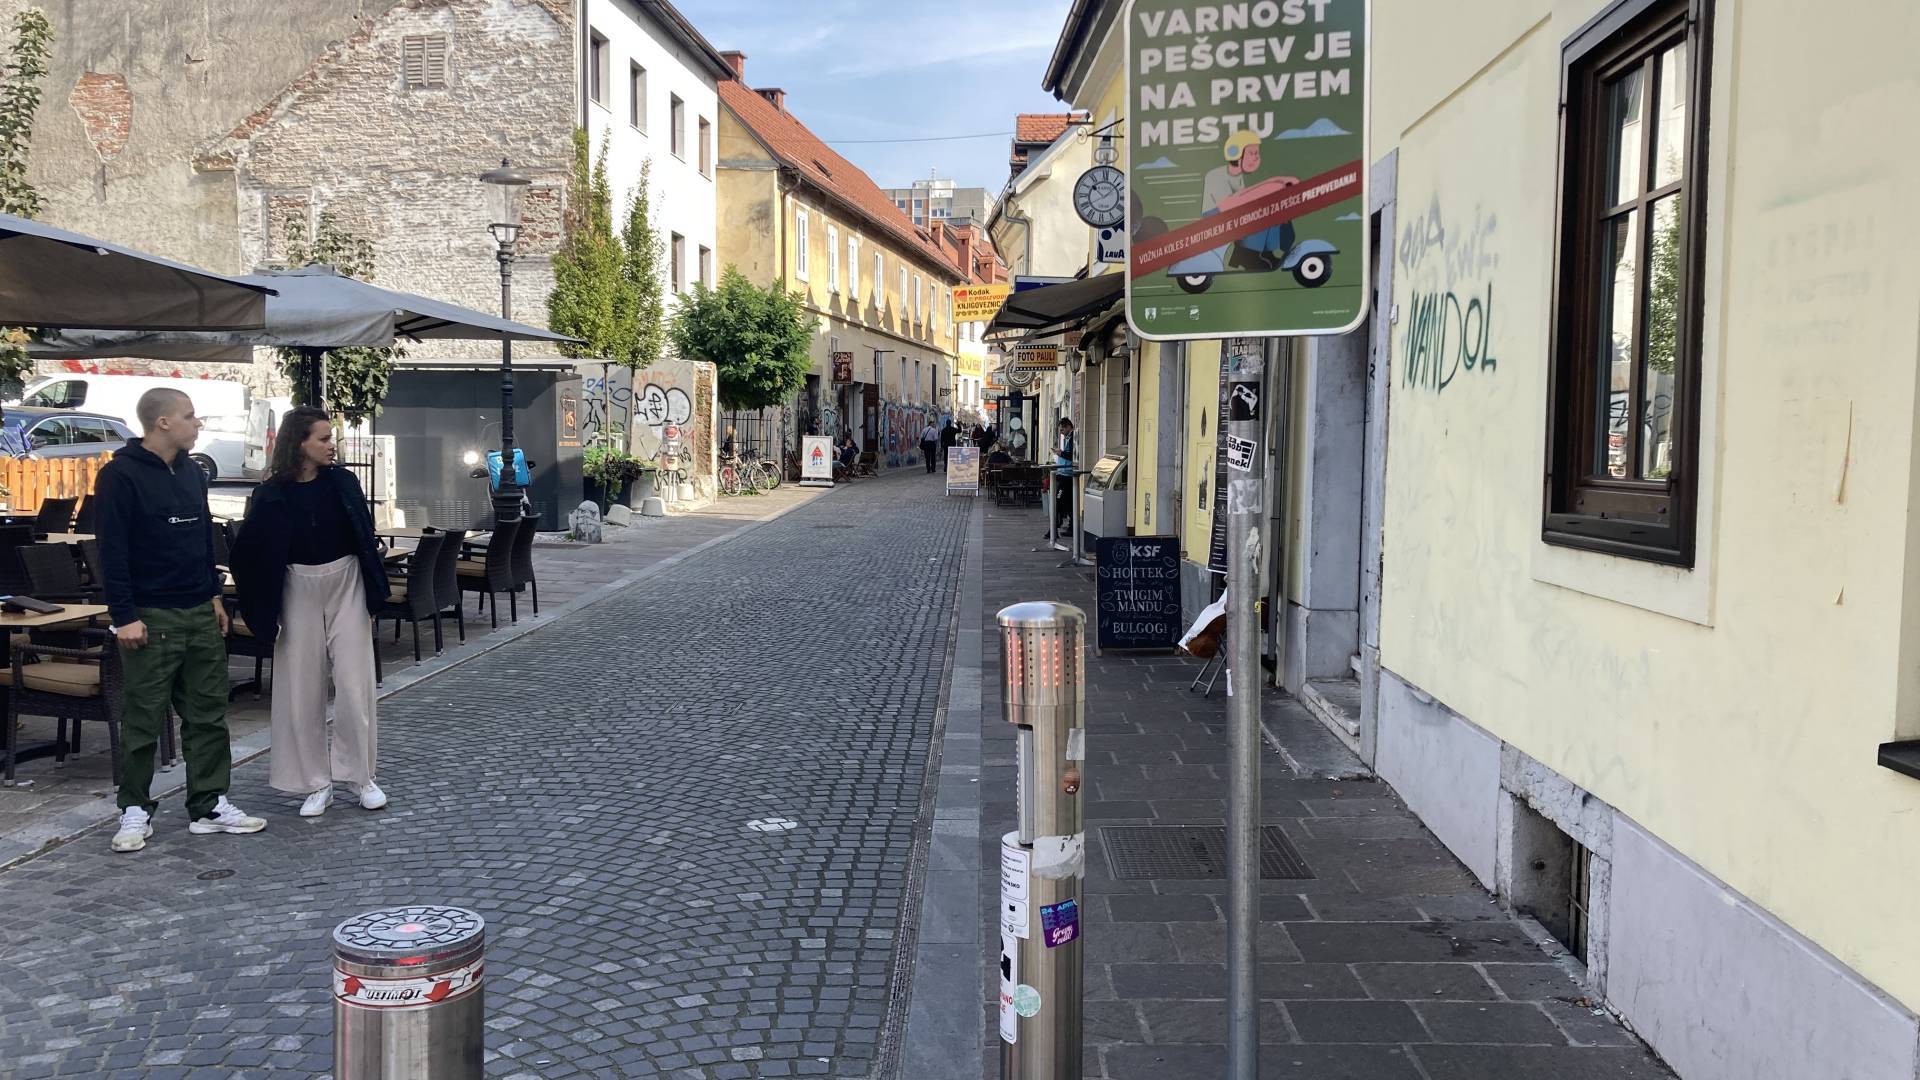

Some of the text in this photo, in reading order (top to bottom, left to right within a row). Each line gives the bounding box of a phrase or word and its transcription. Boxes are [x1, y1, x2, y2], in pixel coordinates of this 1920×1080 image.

[1139, 0, 1331, 38] VARNOST
[1140, 31, 1351, 75] PEŠCEV JE
[1140, 68, 1350, 111] NA PRVEM
[1140, 112, 1275, 148] MESTU
[1139, 247, 1163, 264] VOŽNJA
[1164, 240, 1184, 255] KOLES
[1185, 237, 1190, 247] Z
[1190, 224, 1225, 244] MOTORJEM
[1225, 221, 1233, 231] JE
[1233, 218, 1239, 228] V
[1270, 203, 1280, 215] ZA
[1301, 172, 1357, 203] PREPOVEDANA!
[968, 288, 990, 296] Kodak
[957, 301, 1003, 309] KNJIGOVEZNIC
[1017, 351, 1055, 361] FOTO PAULI
[1131, 545, 1161, 557] KSF
[1112, 567, 1164, 578] HOTTEK
[1115, 589, 1163, 601] TWIGIM
[1118, 601, 1162, 612] MANDU
